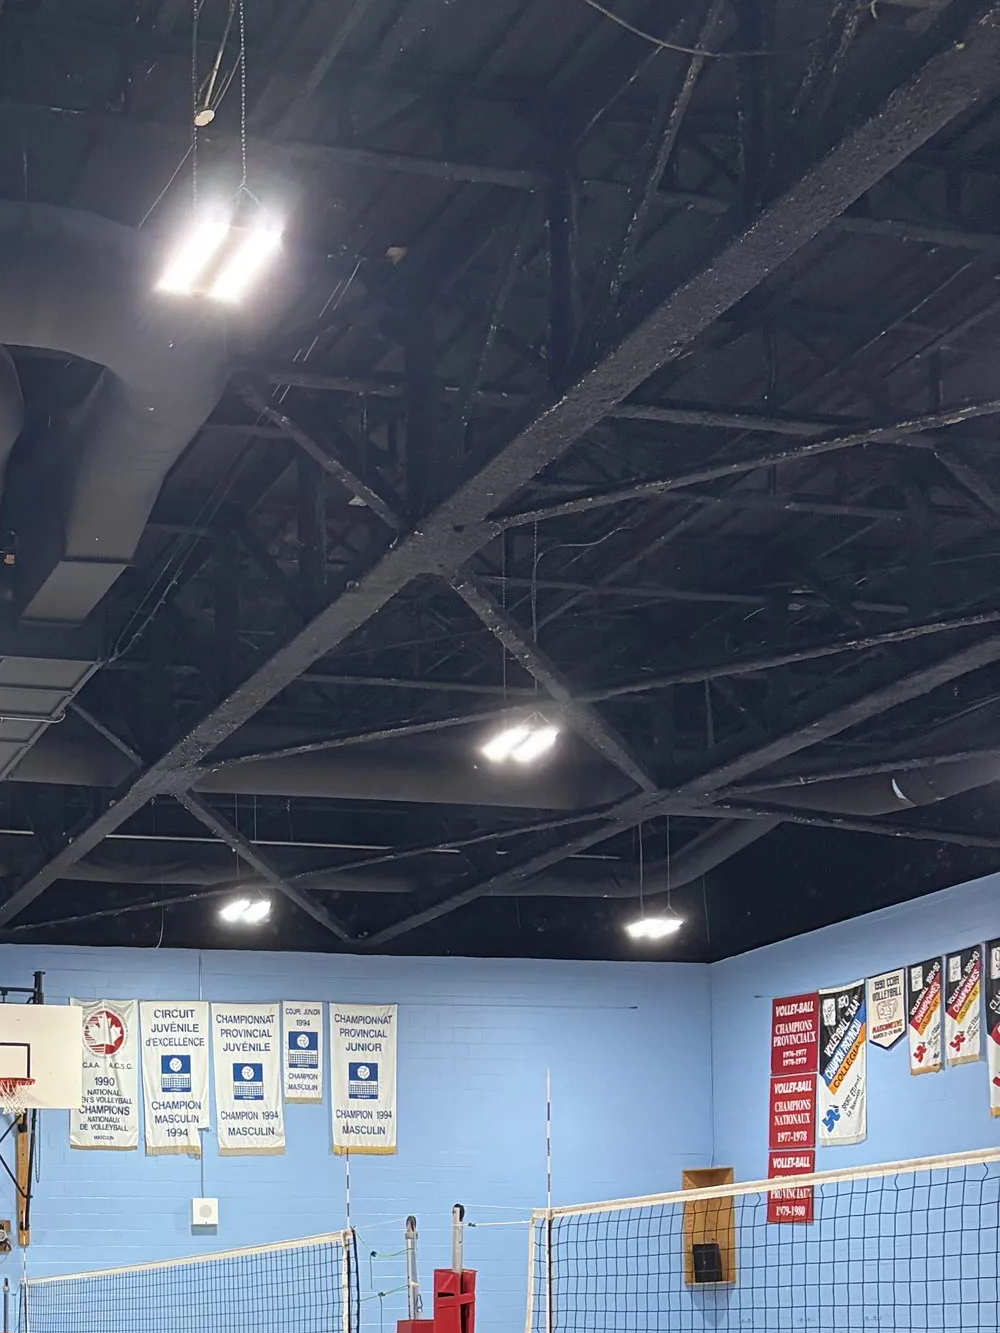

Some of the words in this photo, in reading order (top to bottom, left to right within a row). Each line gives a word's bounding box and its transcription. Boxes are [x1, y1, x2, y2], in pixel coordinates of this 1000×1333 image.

[872, 986, 902, 1002] VOLLEYBALL
[953, 969, 980, 1013] CHAMPIONNES
[916, 981, 940, 1023] CHAMPIONNES
[154, 1010, 195, 1018] CIRCUIT
[776, 1001, 814, 1017] VOLLEY-BALL
[216, 1015, 275, 1024] CHAMPIONNAT
[334, 1014, 392, 1024] CHAMPIONNAT
[151, 1022, 199, 1033] JUVÉNILE
[776, 1019, 812, 1035] CHAMPIONS
[220, 1029, 272, 1038] PROVINCIAL
[340, 1028, 387, 1038] PROVINCIAL
[824, 1018, 850, 1057] VOLLEYBALL
[773, 1031, 816, 1047] PROVINCIAUX
[223, 1041, 270, 1051] JUVÉNILE
[346, 1043, 381, 1052] JUNIOR
[825, 1047, 846, 1080] CHAMPION
[840, 1019, 862, 1054] PROVINCIAL
[95, 1077, 115, 1086] 1990
[775, 1080, 812, 1094] VOLLEY-BALL
[96, 1096, 132, 1104] VOLLEYBALL
[79, 1105, 130, 1115] CHAMPIONS
[152, 1101, 201, 1110] CHAMPION
[775, 1099, 811, 1112] CHAMPIONS
[155, 1115, 199, 1124] MASCULIN
[221, 1111, 258, 1120] CHAMPION
[262, 1111, 278, 1120] 1994
[336, 1110, 372, 1119] CHAMPION
[376, 1111, 392, 1119] 1994
[774, 1113, 810, 1126] NATIONAUX
[167, 1128, 188, 1137] 1994
[228, 1127, 275, 1136] MASCULIN
[342, 1125, 385, 1135] MASCULIN
[777, 1131, 807, 1142] 1977-1978
[773, 1157, 810, 1168] VOLLEY-BALL
